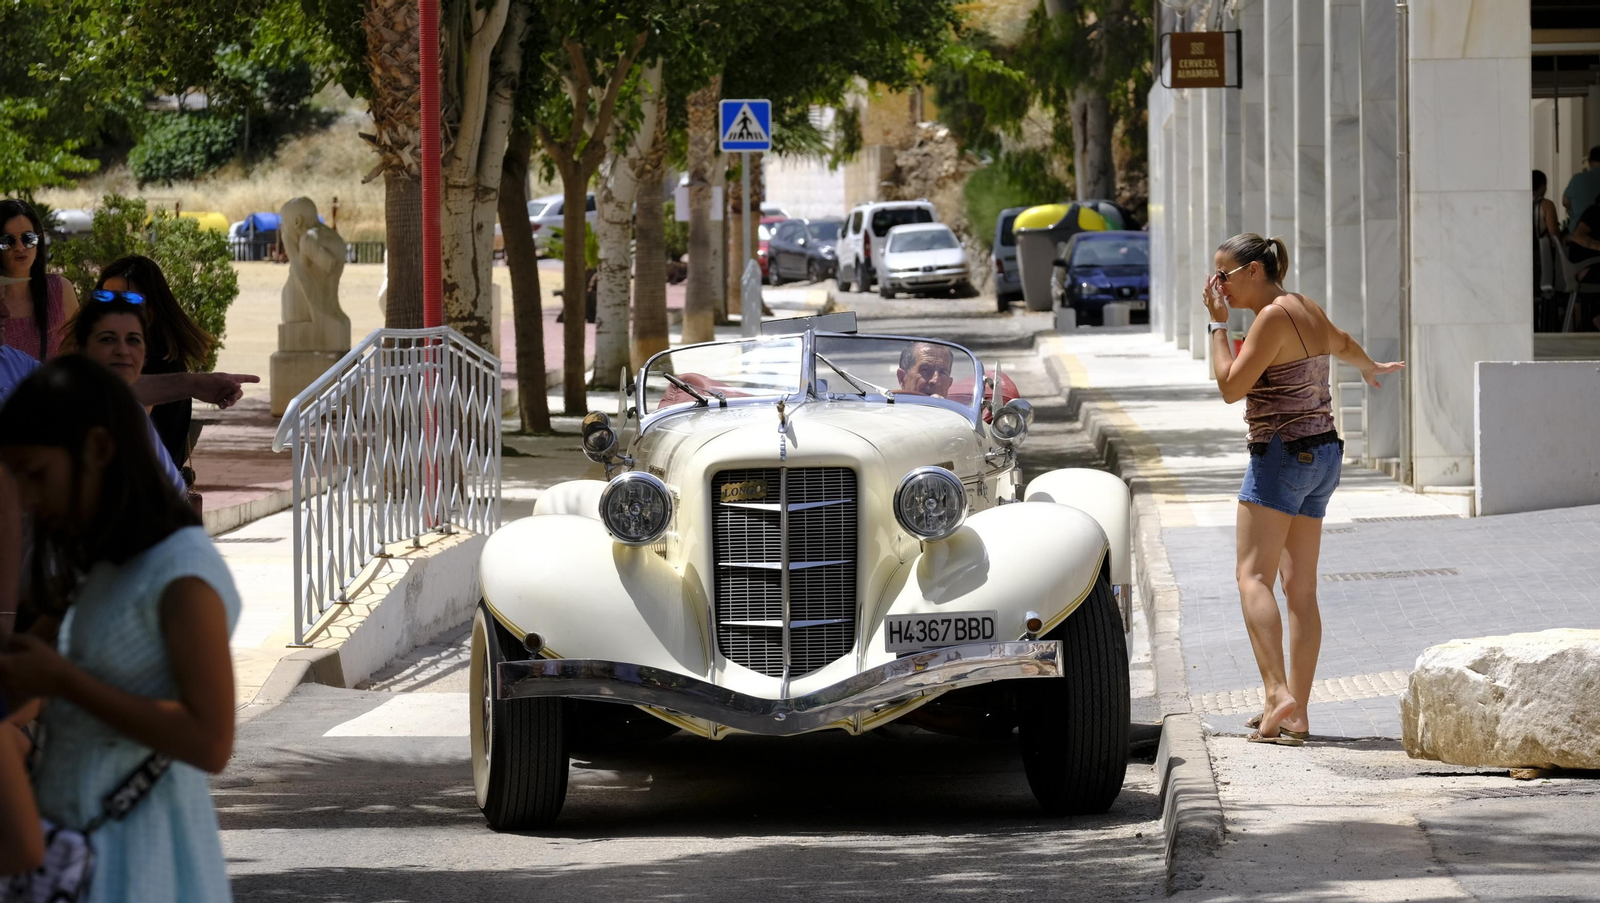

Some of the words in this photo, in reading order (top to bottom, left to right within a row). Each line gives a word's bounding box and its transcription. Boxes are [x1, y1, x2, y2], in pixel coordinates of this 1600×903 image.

[1178, 59, 1217, 68] CERVEZAS
[1177, 69, 1219, 78] ALHAMBRA
[723, 485, 762, 497] LONGO
[889, 617, 995, 644] H4367BBD
